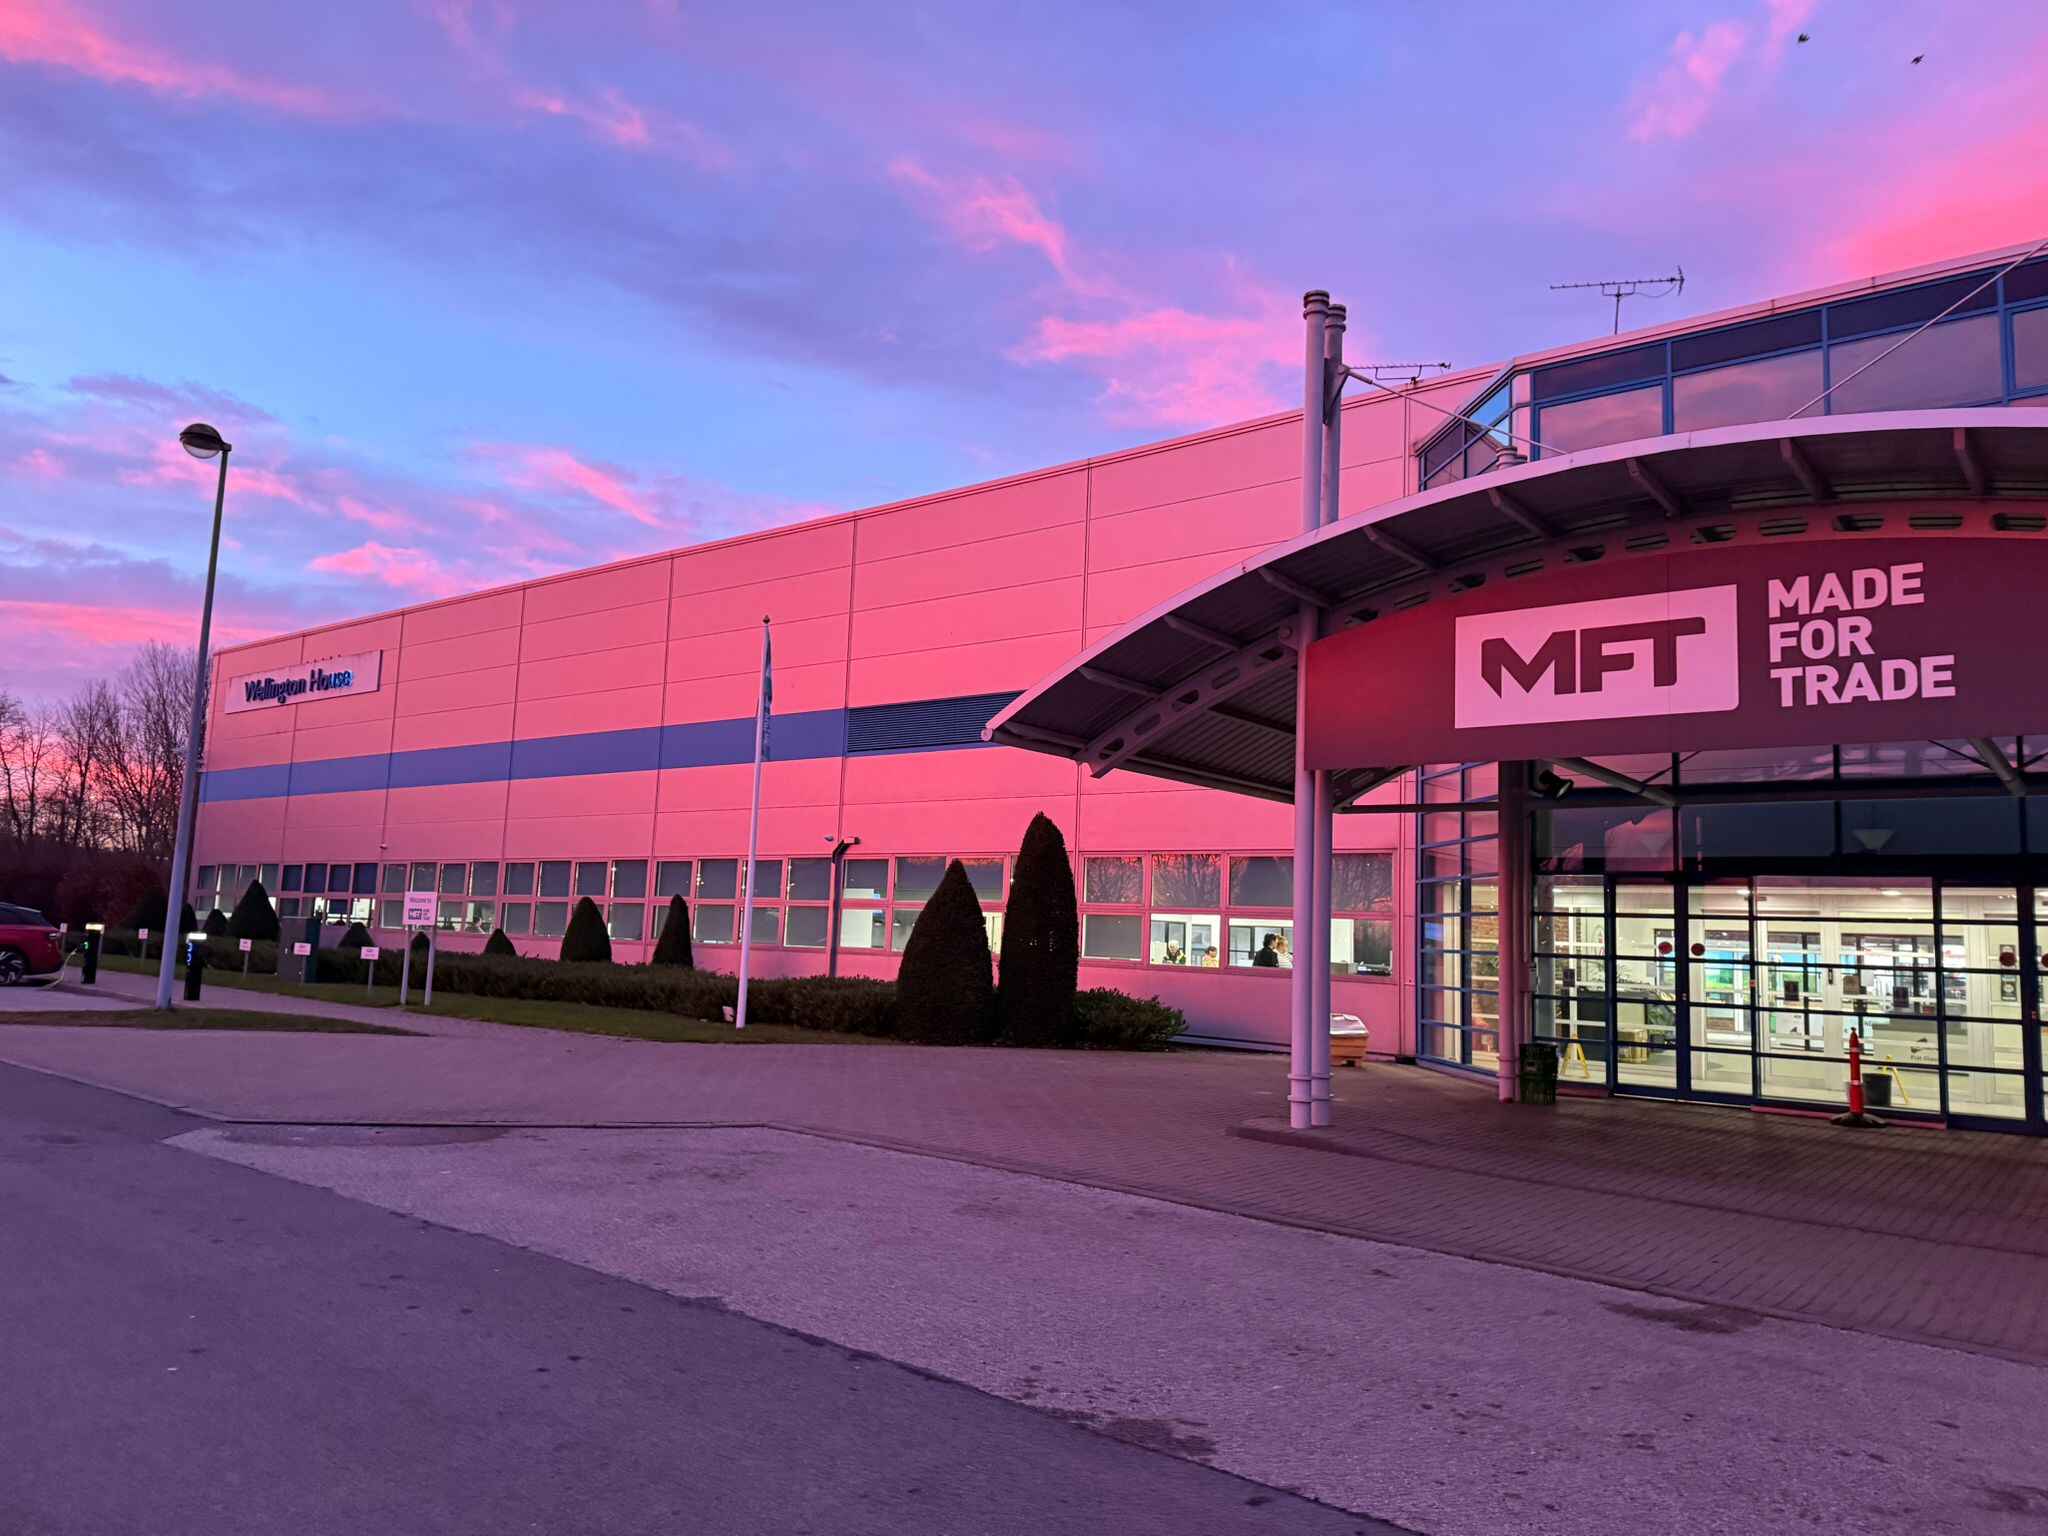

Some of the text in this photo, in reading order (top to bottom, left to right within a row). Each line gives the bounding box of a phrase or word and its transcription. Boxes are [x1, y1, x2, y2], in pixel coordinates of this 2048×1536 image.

[1768, 562, 1925, 618] MADE
[1481, 616, 1706, 699] MFT
[1769, 616, 1876, 662] FOR
[245, 668, 352, 703] Wellington House
[1770, 654, 1957, 708] TRADE
